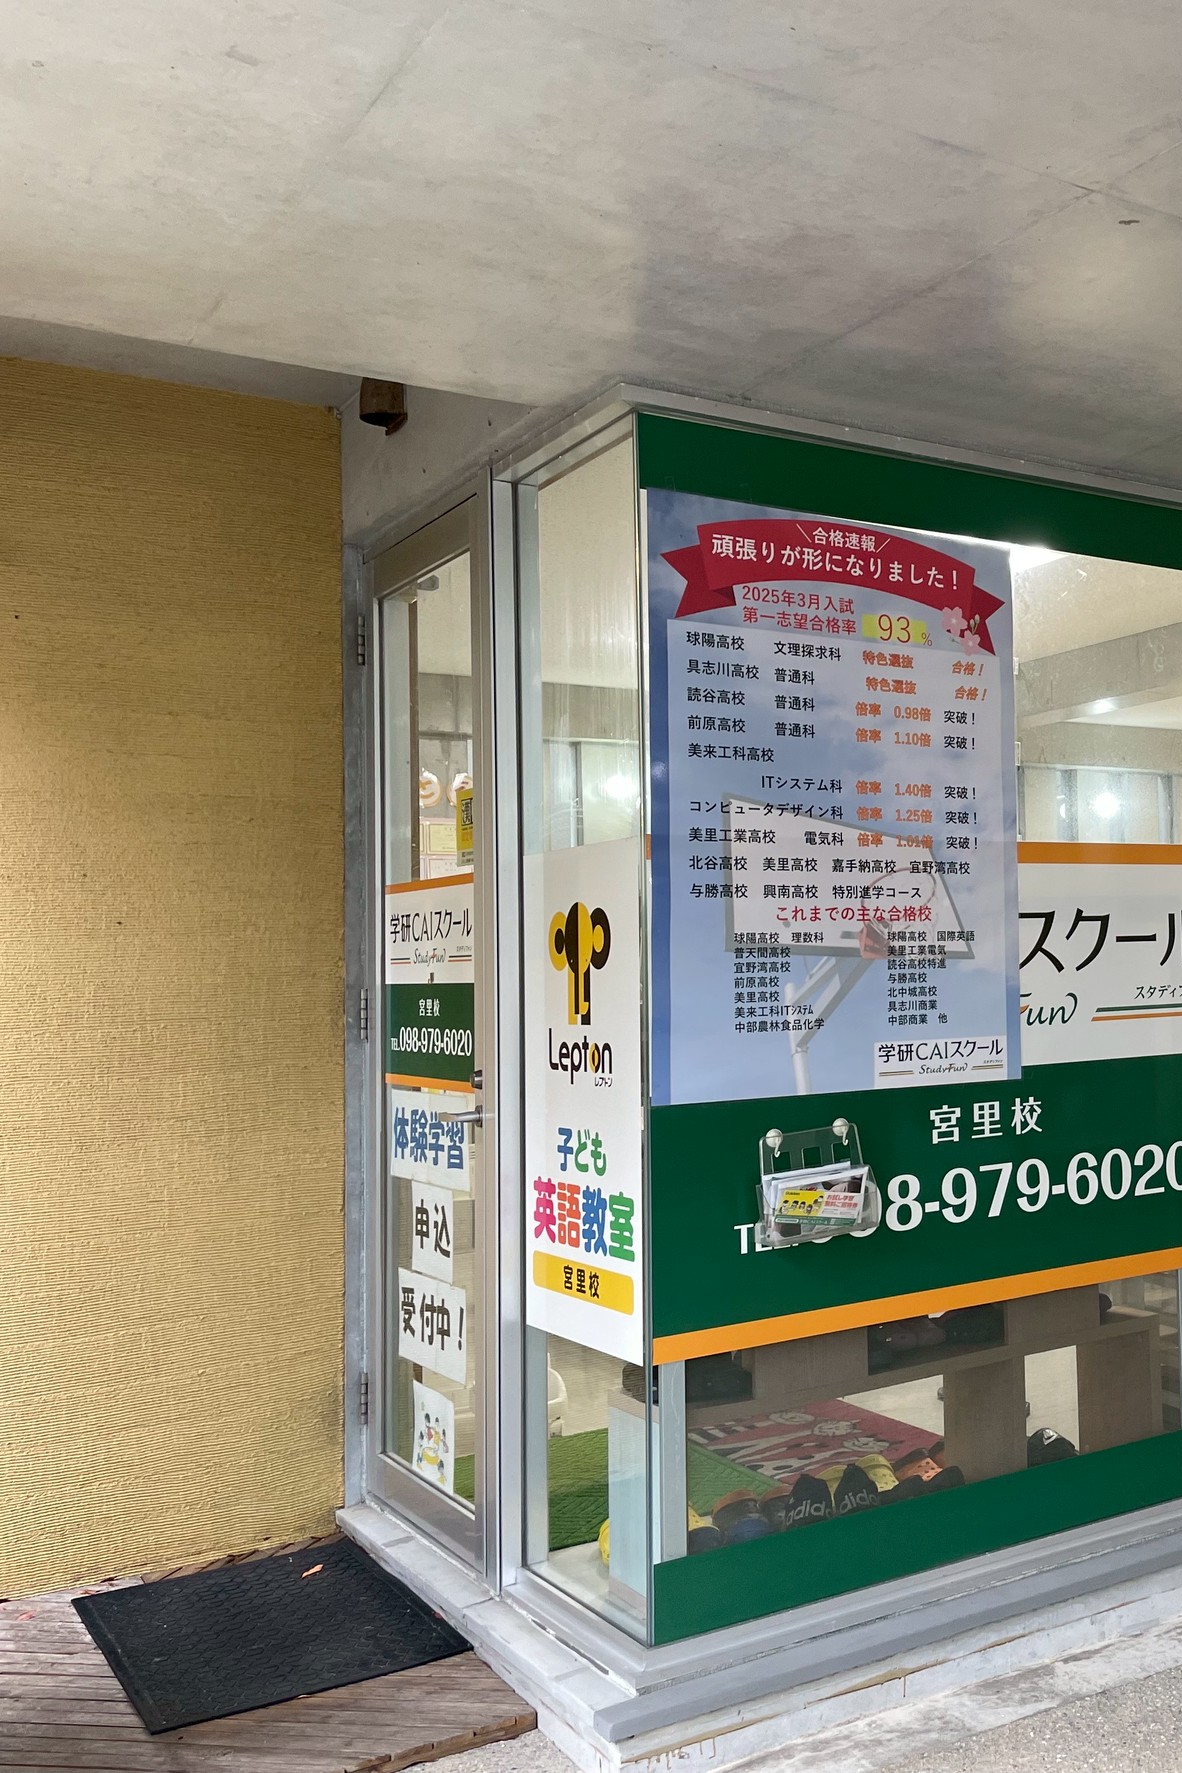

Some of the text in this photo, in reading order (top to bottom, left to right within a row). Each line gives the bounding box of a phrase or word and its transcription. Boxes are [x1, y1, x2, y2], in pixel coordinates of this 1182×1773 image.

[812, 527, 877, 553] 合格速報
[712, 534, 959, 590] 頑張りが形になりました！
[742, 585, 855, 615] 2025年3月入試
[742, 606, 857, 635] 第一志望合格率
[686, 631, 745, 651] 球陽高校
[773, 641, 842, 661] 文理探求科
[686, 659, 760, 680] 具志川高校
[774, 668, 815, 685] 普通科
[686, 686, 976, 725] 読谷高校 普通科 倍率 0.98倍 突破！
[687, 715, 976, 750] 前原高校 普通科 倍率 1.10倍 突破！
[687, 743, 775, 763] 美来工科高校
[761, 775, 977, 800] ITシステム科 倍率 1.40倍 突破！
[689, 801, 978, 825] コンピュータデザイン科 倍率 1.25倍 突破！
[688, 827, 776, 844] 美里工業高校
[804, 831, 844, 846] 電気科
[857, 832, 883, 847] 倍率
[946, 836, 978, 850] 突破！
[689, 856, 970, 875] 北谷高校 美里高校 嘉手納高校 宜野湾高校
[689, 883, 922, 900] 与勝高校 興南高校 特別進学コース
[390, 908, 472, 943] 学研CAIスクール
[776, 905, 932, 923] これまでの主な合格校
[734, 932, 824, 944] 球陽高校 理数科
[887, 931, 927, 942] 球陽高校
[734, 947, 791, 959] 普天間高校
[734, 976, 779, 989] 前原高校
[887, 972, 927, 984] 与勝高校
[734, 991, 780, 1003] 美里高校
[887, 986, 937, 998] 北中城高校
[419, 998, 440, 1016] 宮里校
[887, 1000, 938, 1012] 具志川商業
[734, 1019, 825, 1033] 中部農林食品化学
[887, 1013, 928, 1026] 中部商業
[400, 1026, 472, 1056] 098-979-6020
[879, 1039, 1003, 1063] 学研CAIスクール
[549, 1027, 613, 1085] Lepton
[929, 1096, 1043, 1145] 宮里校
[393, 1106, 465, 1170] 体験学習
[557, 1127, 607, 1177] 子ども
[415, 1198, 451, 1258] 申込
[533, 1176, 635, 1262] 英語教室
[563, 1264, 600, 1300] 宮里校
[400, 1286, 464, 1351] 受付中！
